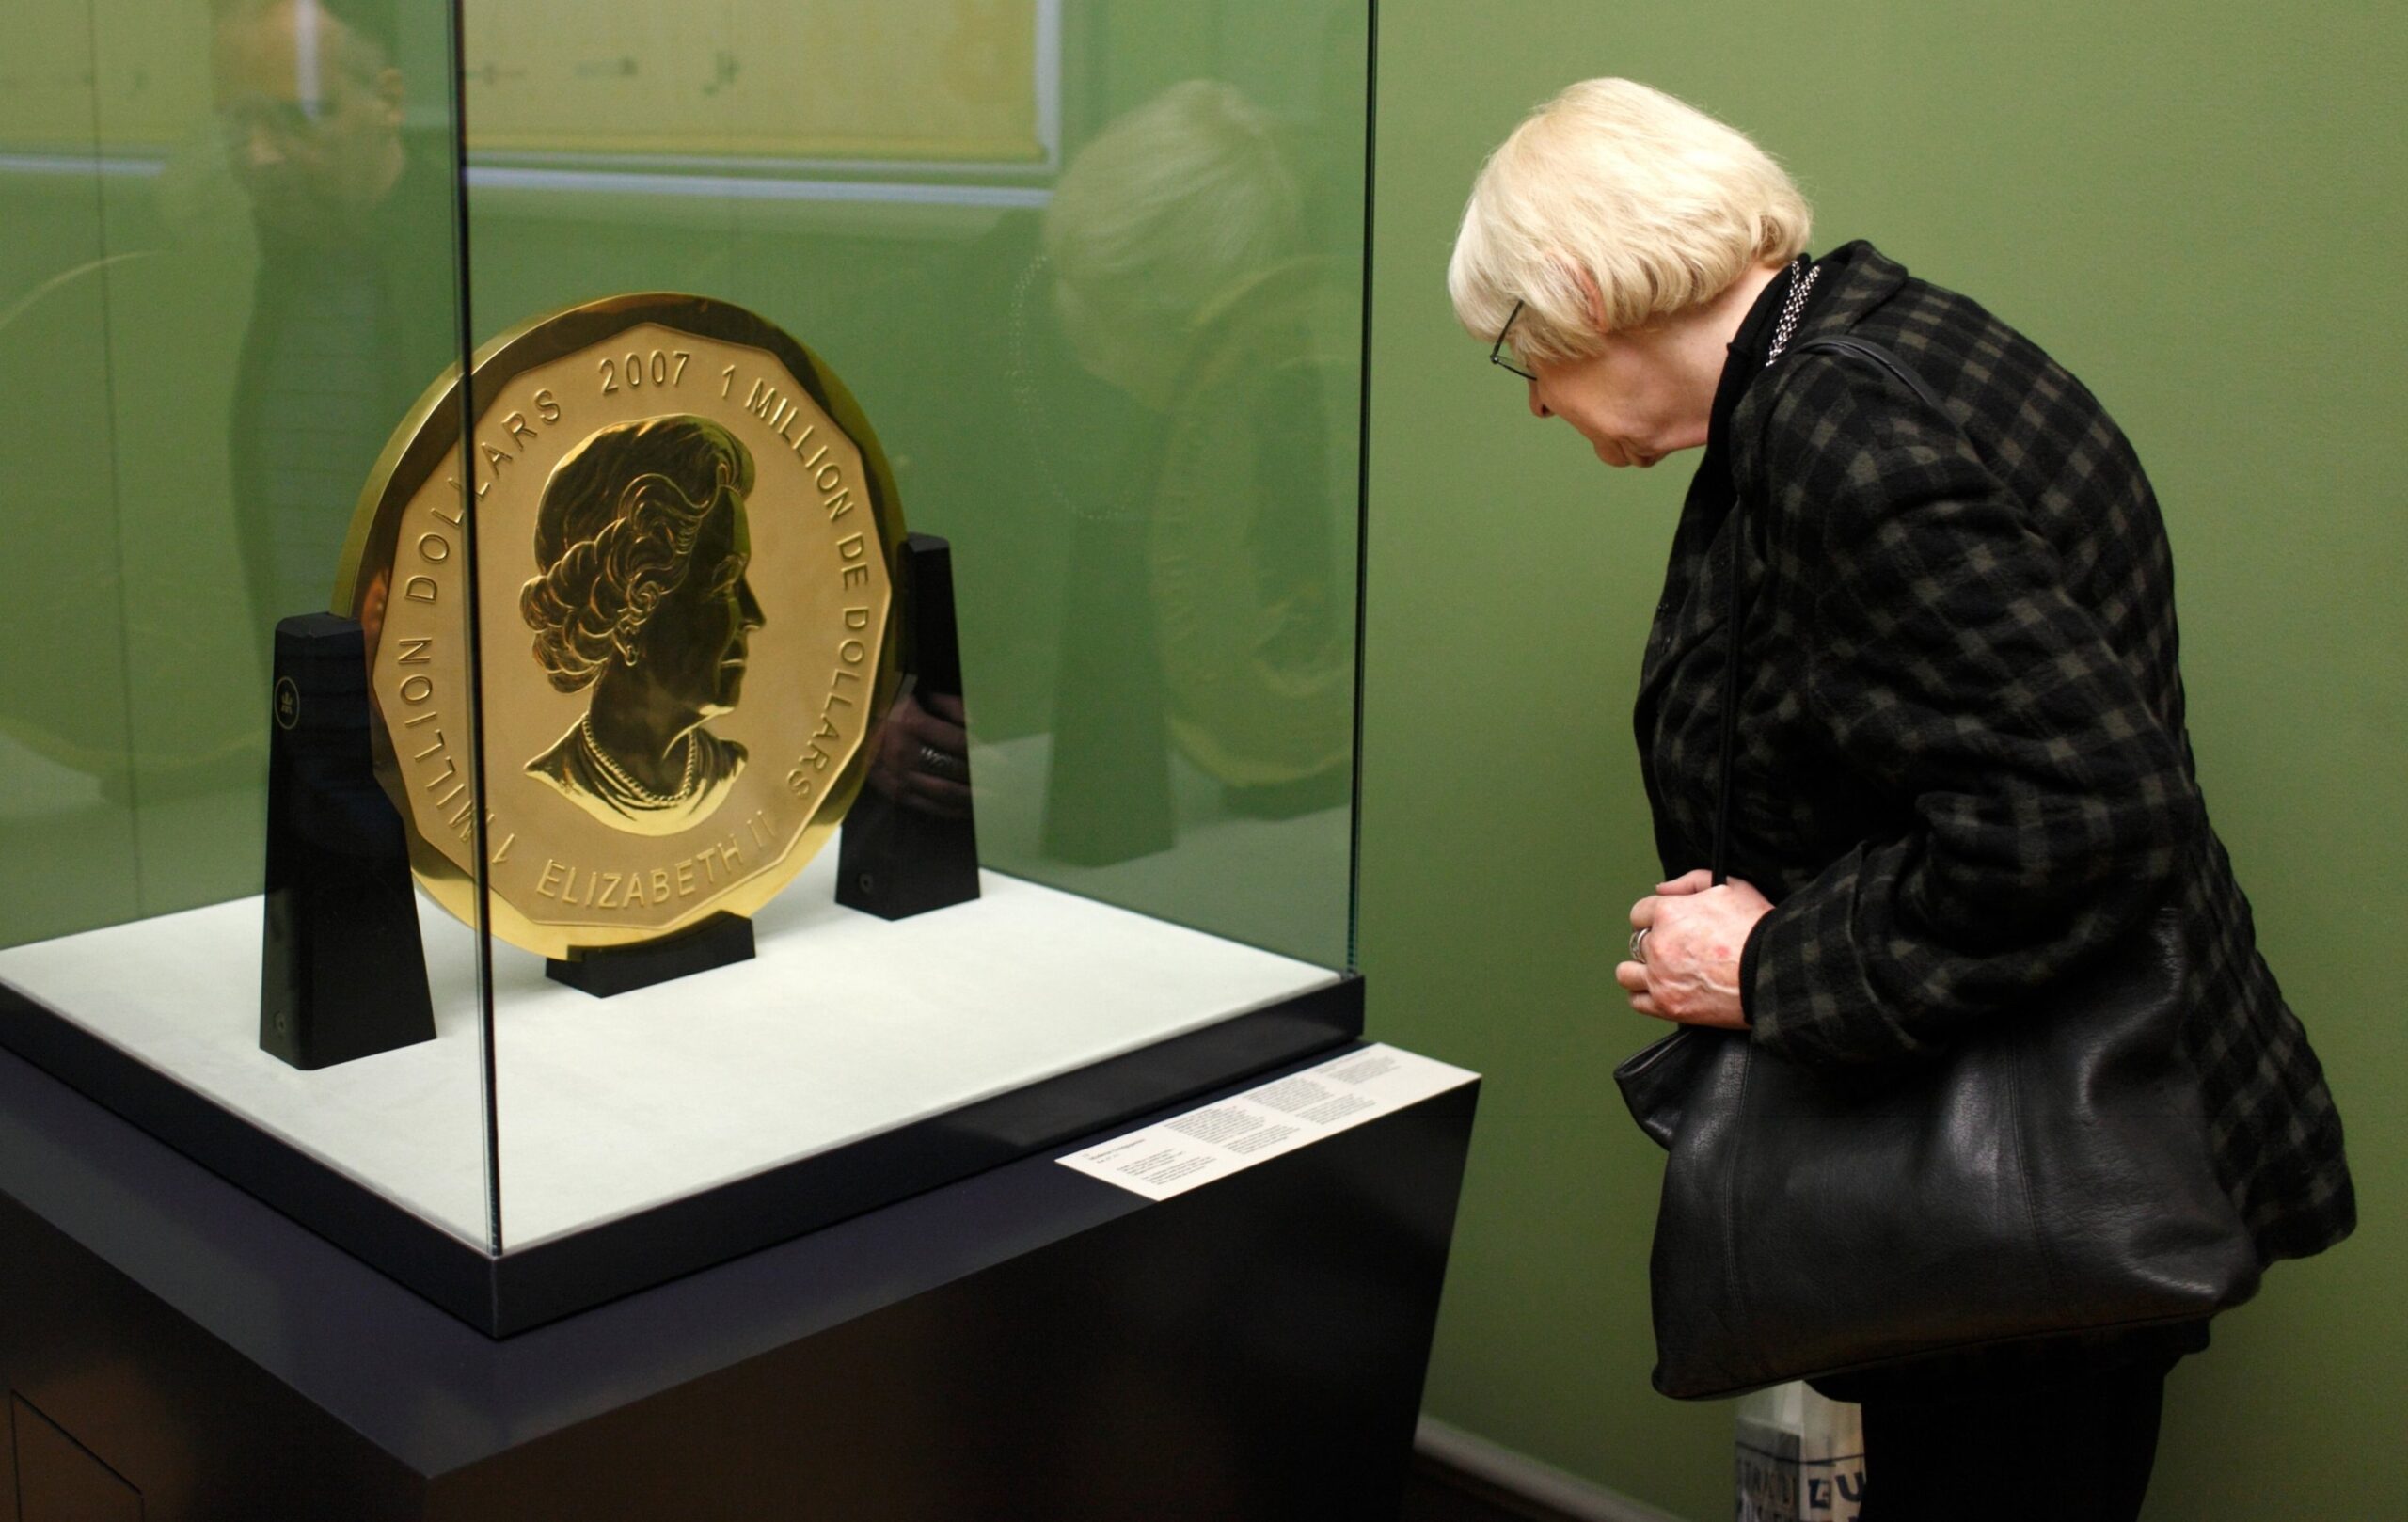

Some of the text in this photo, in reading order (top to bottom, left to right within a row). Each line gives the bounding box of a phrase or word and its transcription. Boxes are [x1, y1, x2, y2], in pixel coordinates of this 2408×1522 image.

[599, 349, 690, 396] 2007
[721, 364, 870, 799] 1 MILLION DE DOLLARS
[492, 833, 516, 864] 1
[536, 809, 777, 910] ELIZABETH II
